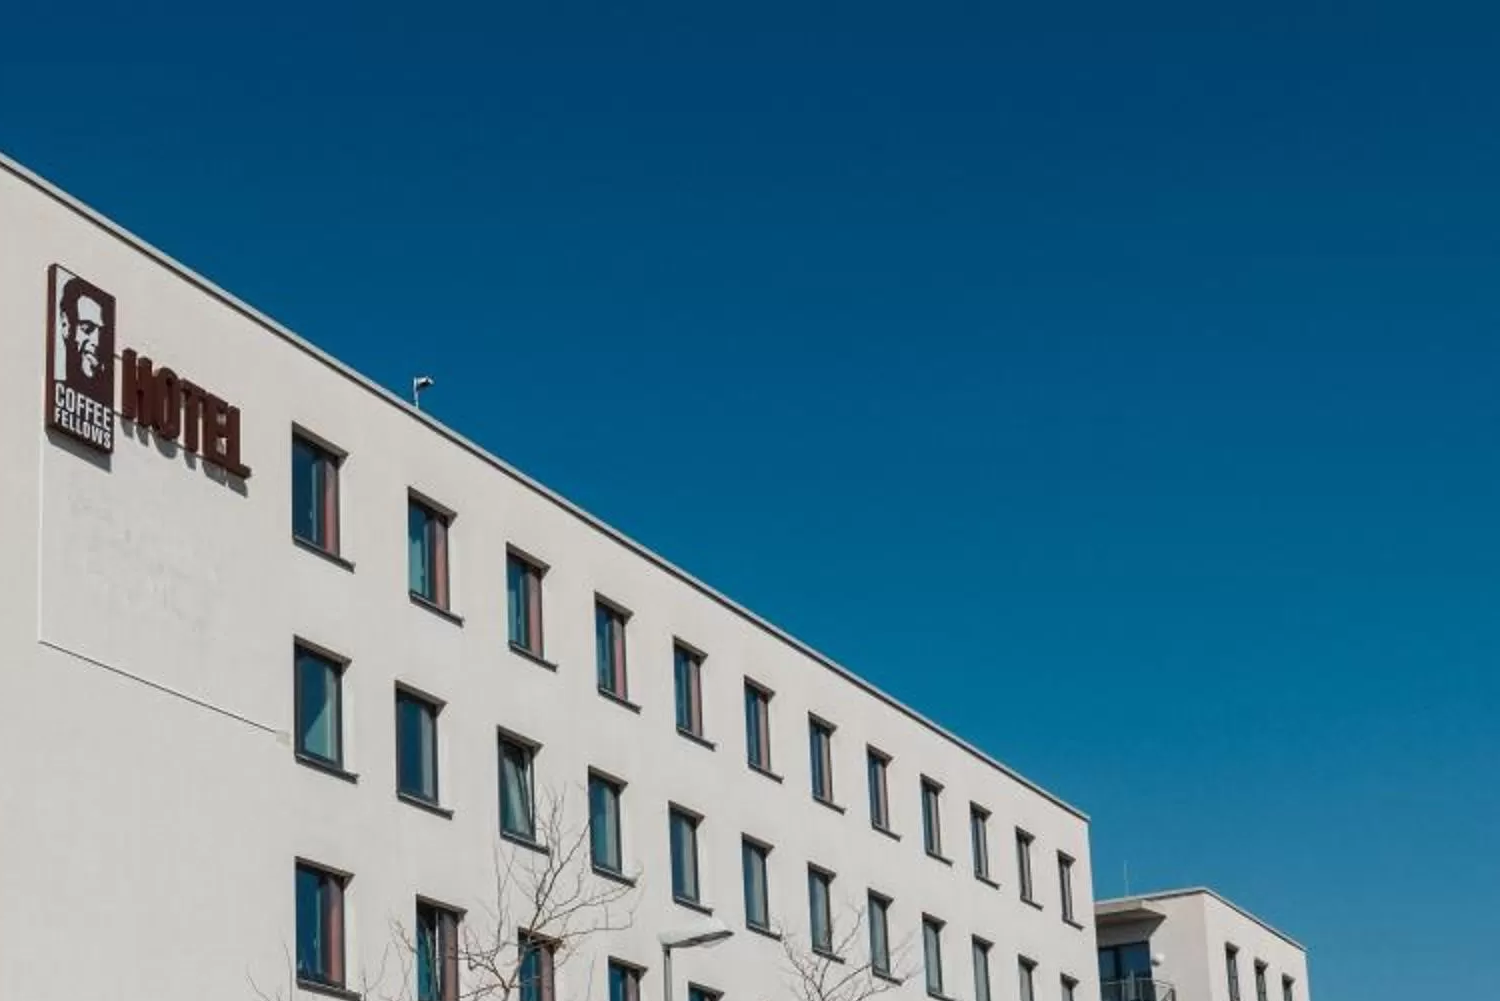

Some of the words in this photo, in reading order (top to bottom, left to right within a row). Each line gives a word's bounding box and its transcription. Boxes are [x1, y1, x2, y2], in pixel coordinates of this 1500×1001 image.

[54, 407, 111, 449] FELLOWS
[55, 383, 111, 431] COFFEE
[122, 348, 251, 478] HOTEL
